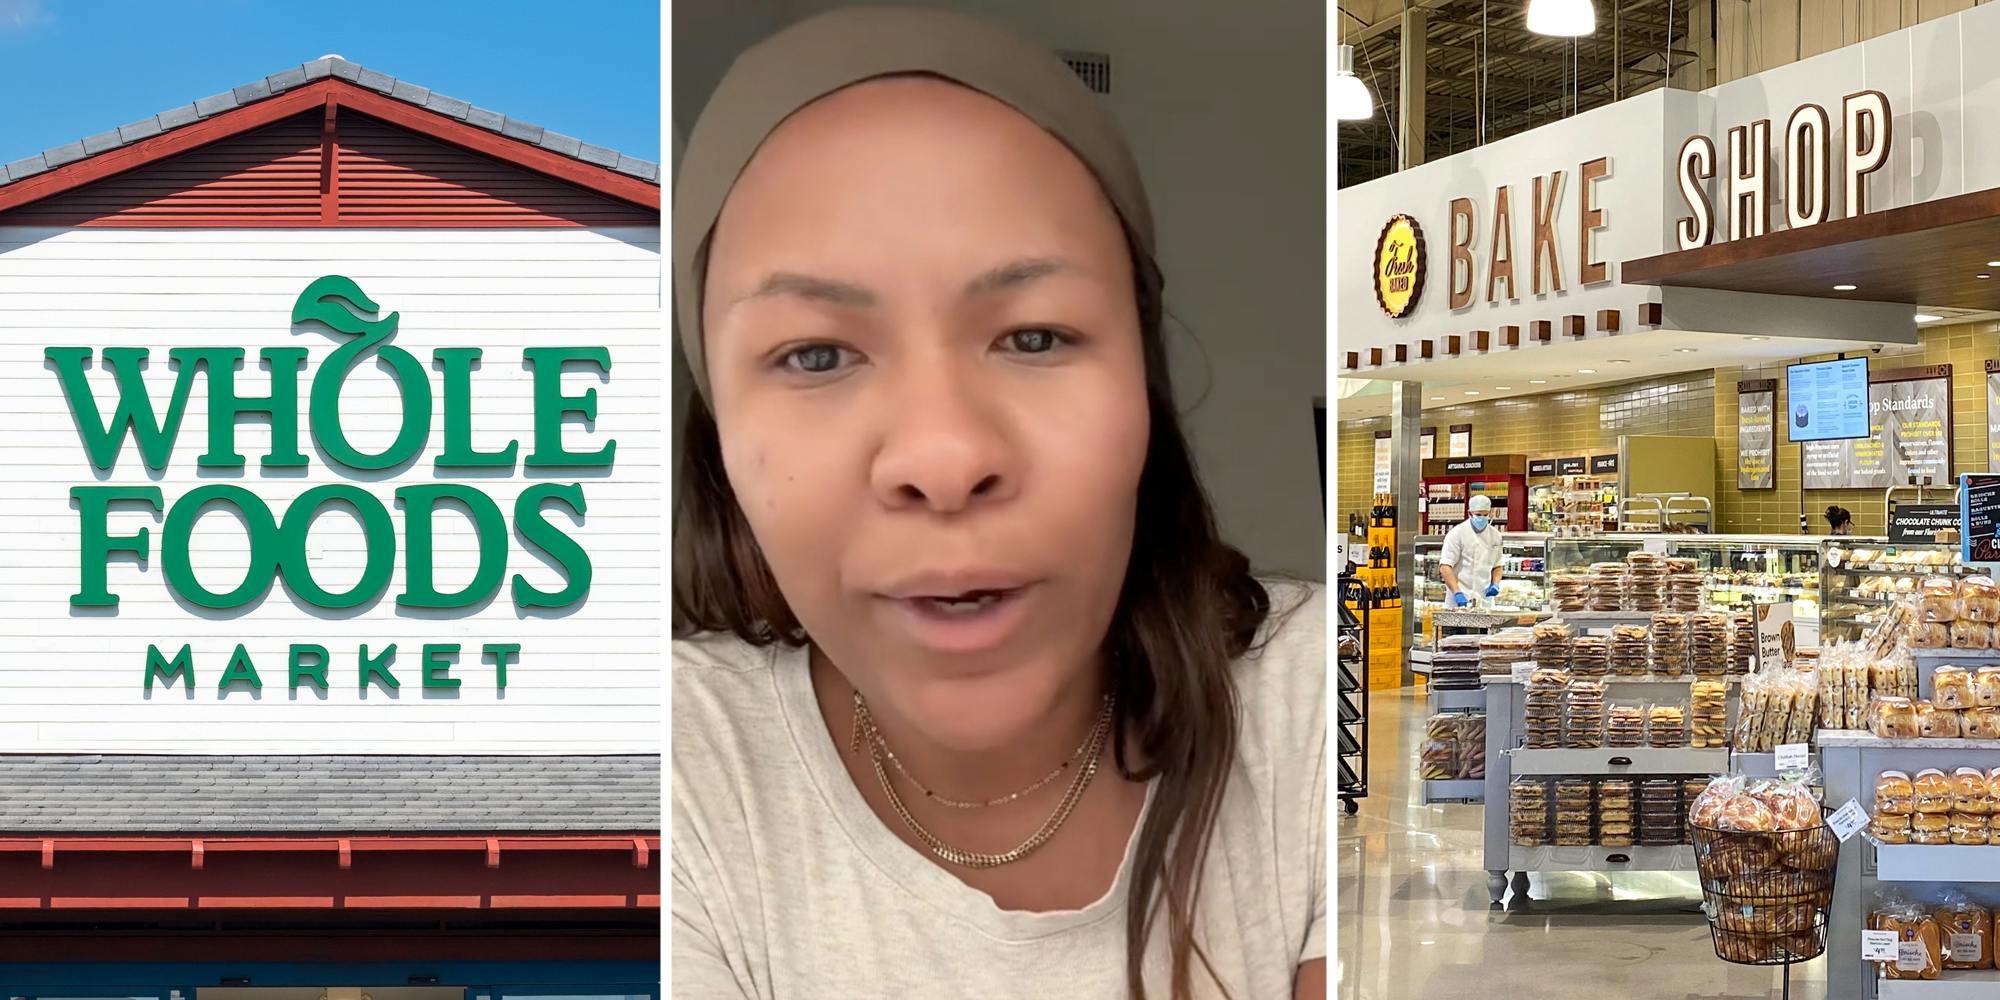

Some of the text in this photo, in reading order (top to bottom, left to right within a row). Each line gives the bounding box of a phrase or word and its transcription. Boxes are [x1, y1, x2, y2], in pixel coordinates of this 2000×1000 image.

[1448, 89, 1892, 311] BAKE SHOP
[44, 312, 616, 470] WHOLE
[1757, 404, 1771, 412] WITH
[1882, 394, 1935, 412] Standards
[1749, 449, 1771, 457] PROHIBIT
[1930, 518, 1953, 526] CHUNK
[1902, 528, 1914, 537] from
[70, 483, 592, 609] FOODS
[1760, 632, 1780, 643] Brown
[1761, 646, 1780, 658] Butter
[144, 643, 521, 690] MARKET
